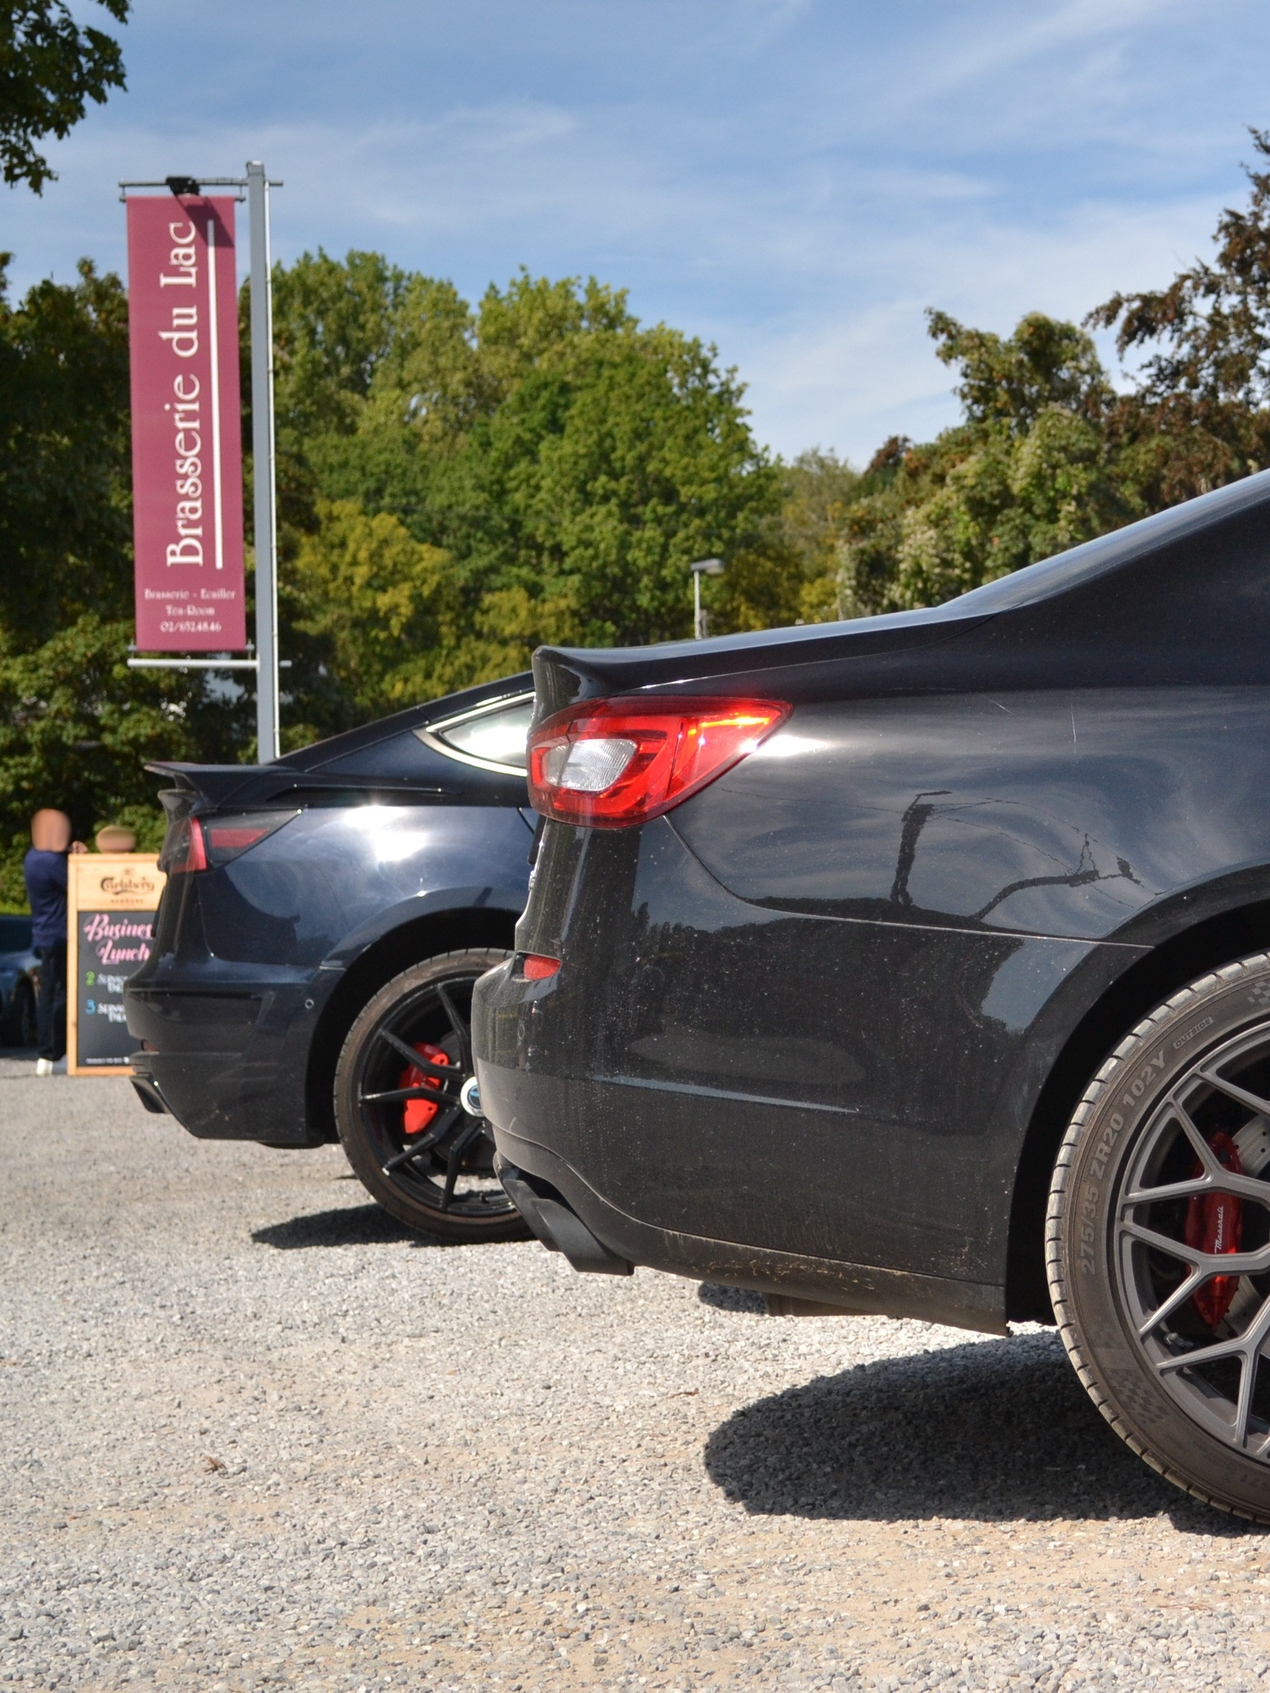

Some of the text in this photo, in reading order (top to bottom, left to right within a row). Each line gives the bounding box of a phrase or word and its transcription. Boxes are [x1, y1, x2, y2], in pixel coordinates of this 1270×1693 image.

[158, 221, 203, 567] Brasserie du Lac
[100, 876, 155, 895] Carlsberg
[84, 914, 152, 942] Busines
[97, 939, 151, 965] Lunch
[86, 971, 95, 987] 2
[85, 999, 96, 1015] 3
[1175, 1018, 1212, 1047] OUTSIDE
[1081, 1051, 1167, 1275] 275/35 ZR20 102Y
[1215, 1205, 1225, 1254] Maserati
